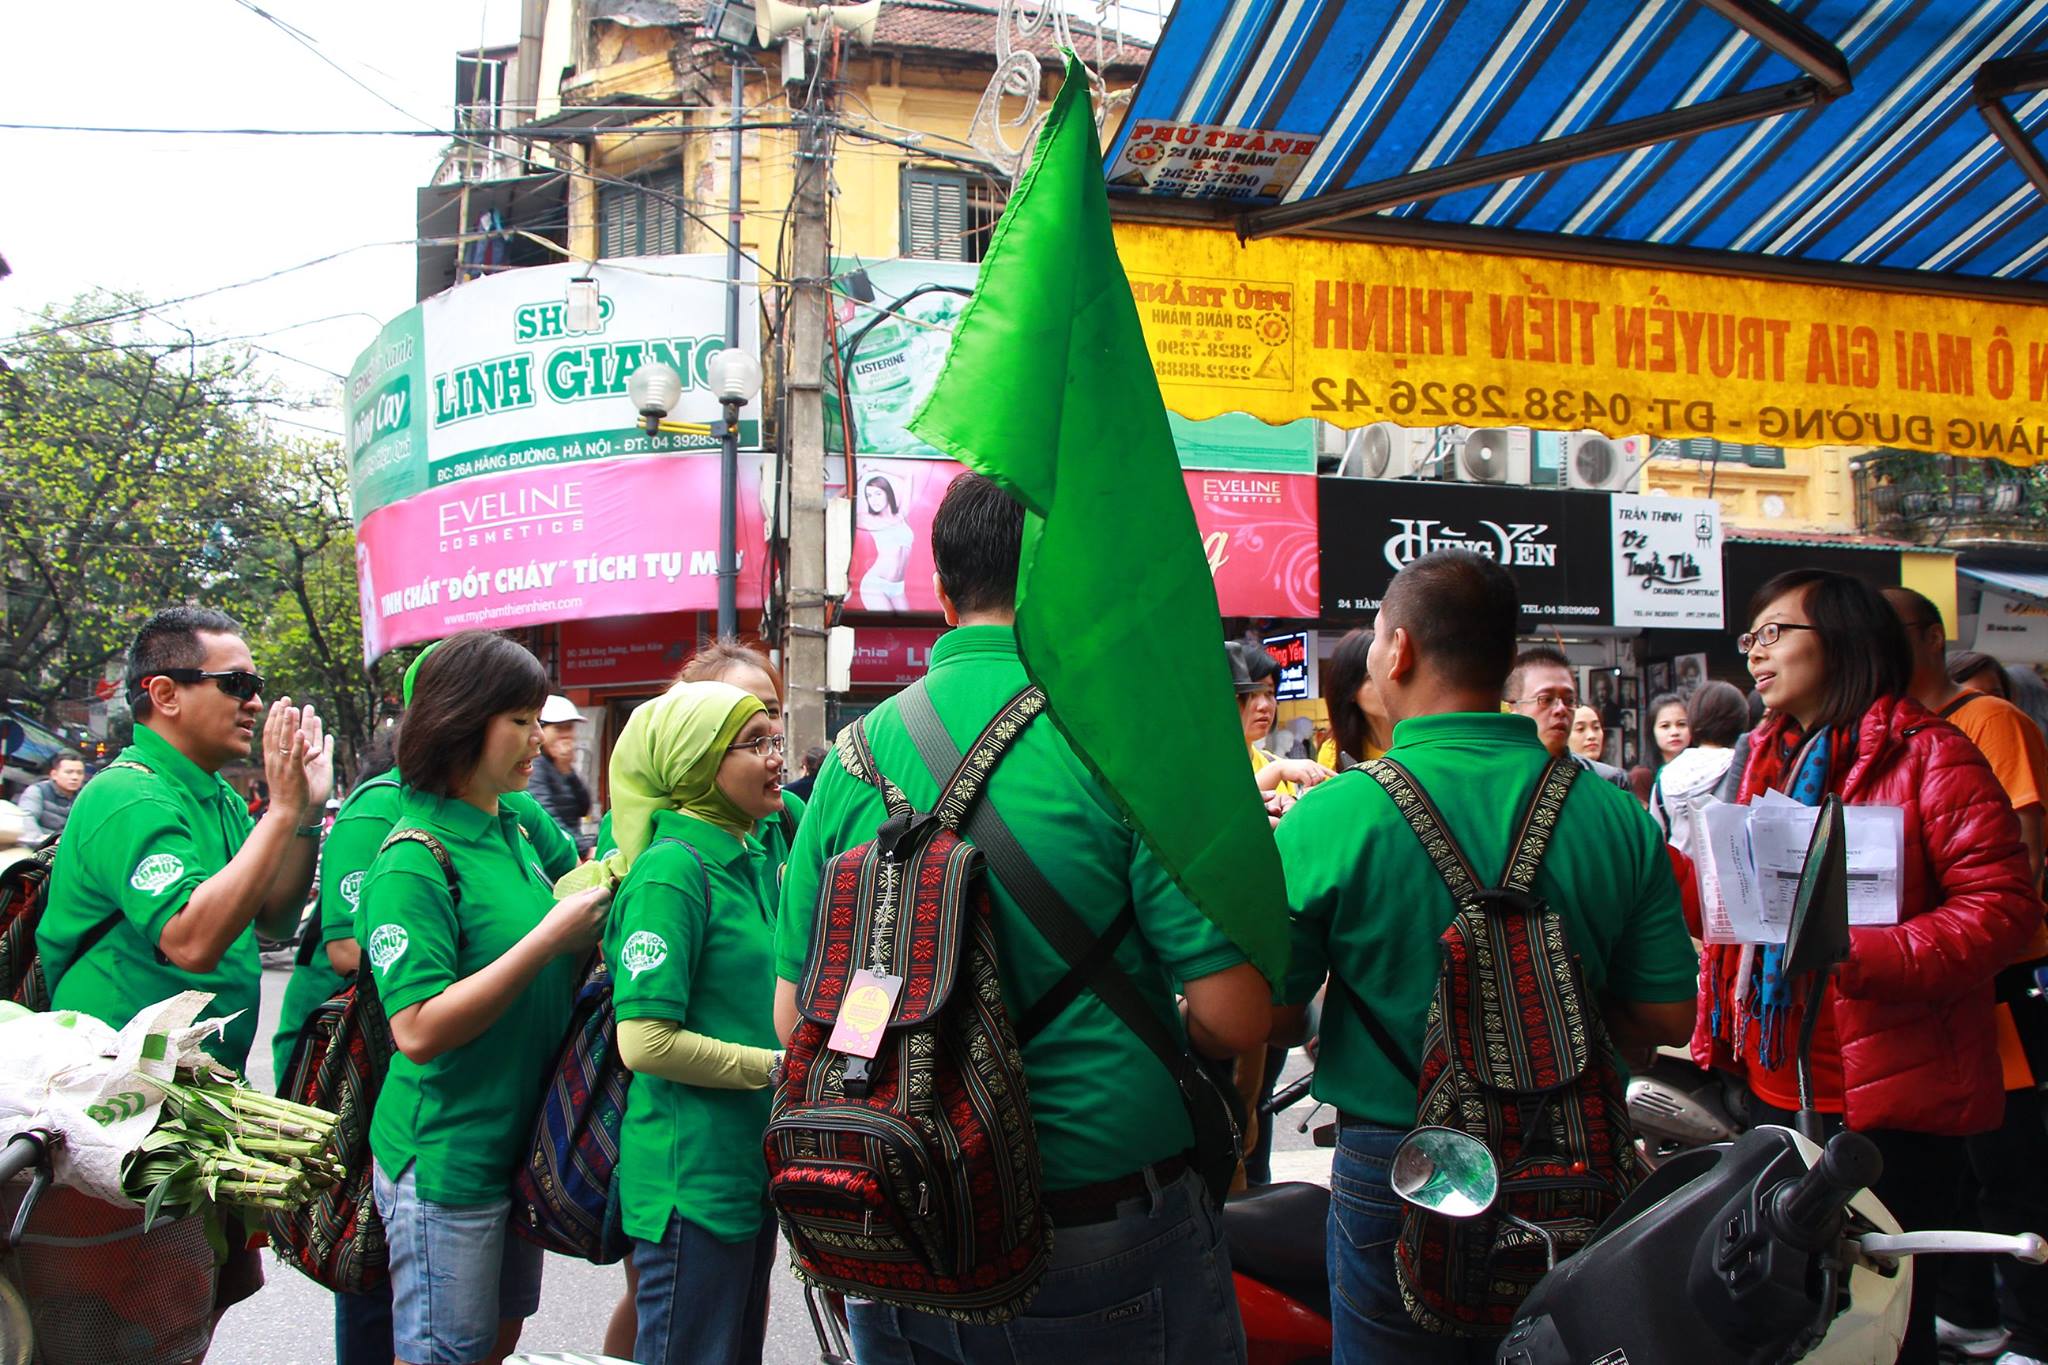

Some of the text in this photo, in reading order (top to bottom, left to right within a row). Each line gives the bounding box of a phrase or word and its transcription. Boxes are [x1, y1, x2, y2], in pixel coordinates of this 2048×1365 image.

[515, 298, 613, 342] SHP
[855, 352, 906, 376] LISTERINE
[435, 355, 533, 425] LINH
[474, 454, 507, 473] HÀNG
[563, 441, 583, 458] HÀ
[586, 438, 612, 457] NỘI
[652, 436, 669, 449] 04
[1203, 478, 1281, 495] EVELINE
[1203, 494, 1282, 504] COSMETICS
[439, 481, 583, 537] EVELINE
[440, 519, 584, 553] COSMETICS
[573, 552, 637, 584] TÍCH
[643, 551, 682, 584] TỤ
[1355, 596, 1382, 609] HÀN
[1544, 604, 1557, 614] 04
[134, 861, 183, 888] LUMUT
[371, 932, 408, 963] LUMUT
[623, 942, 668, 966] LUMUT
